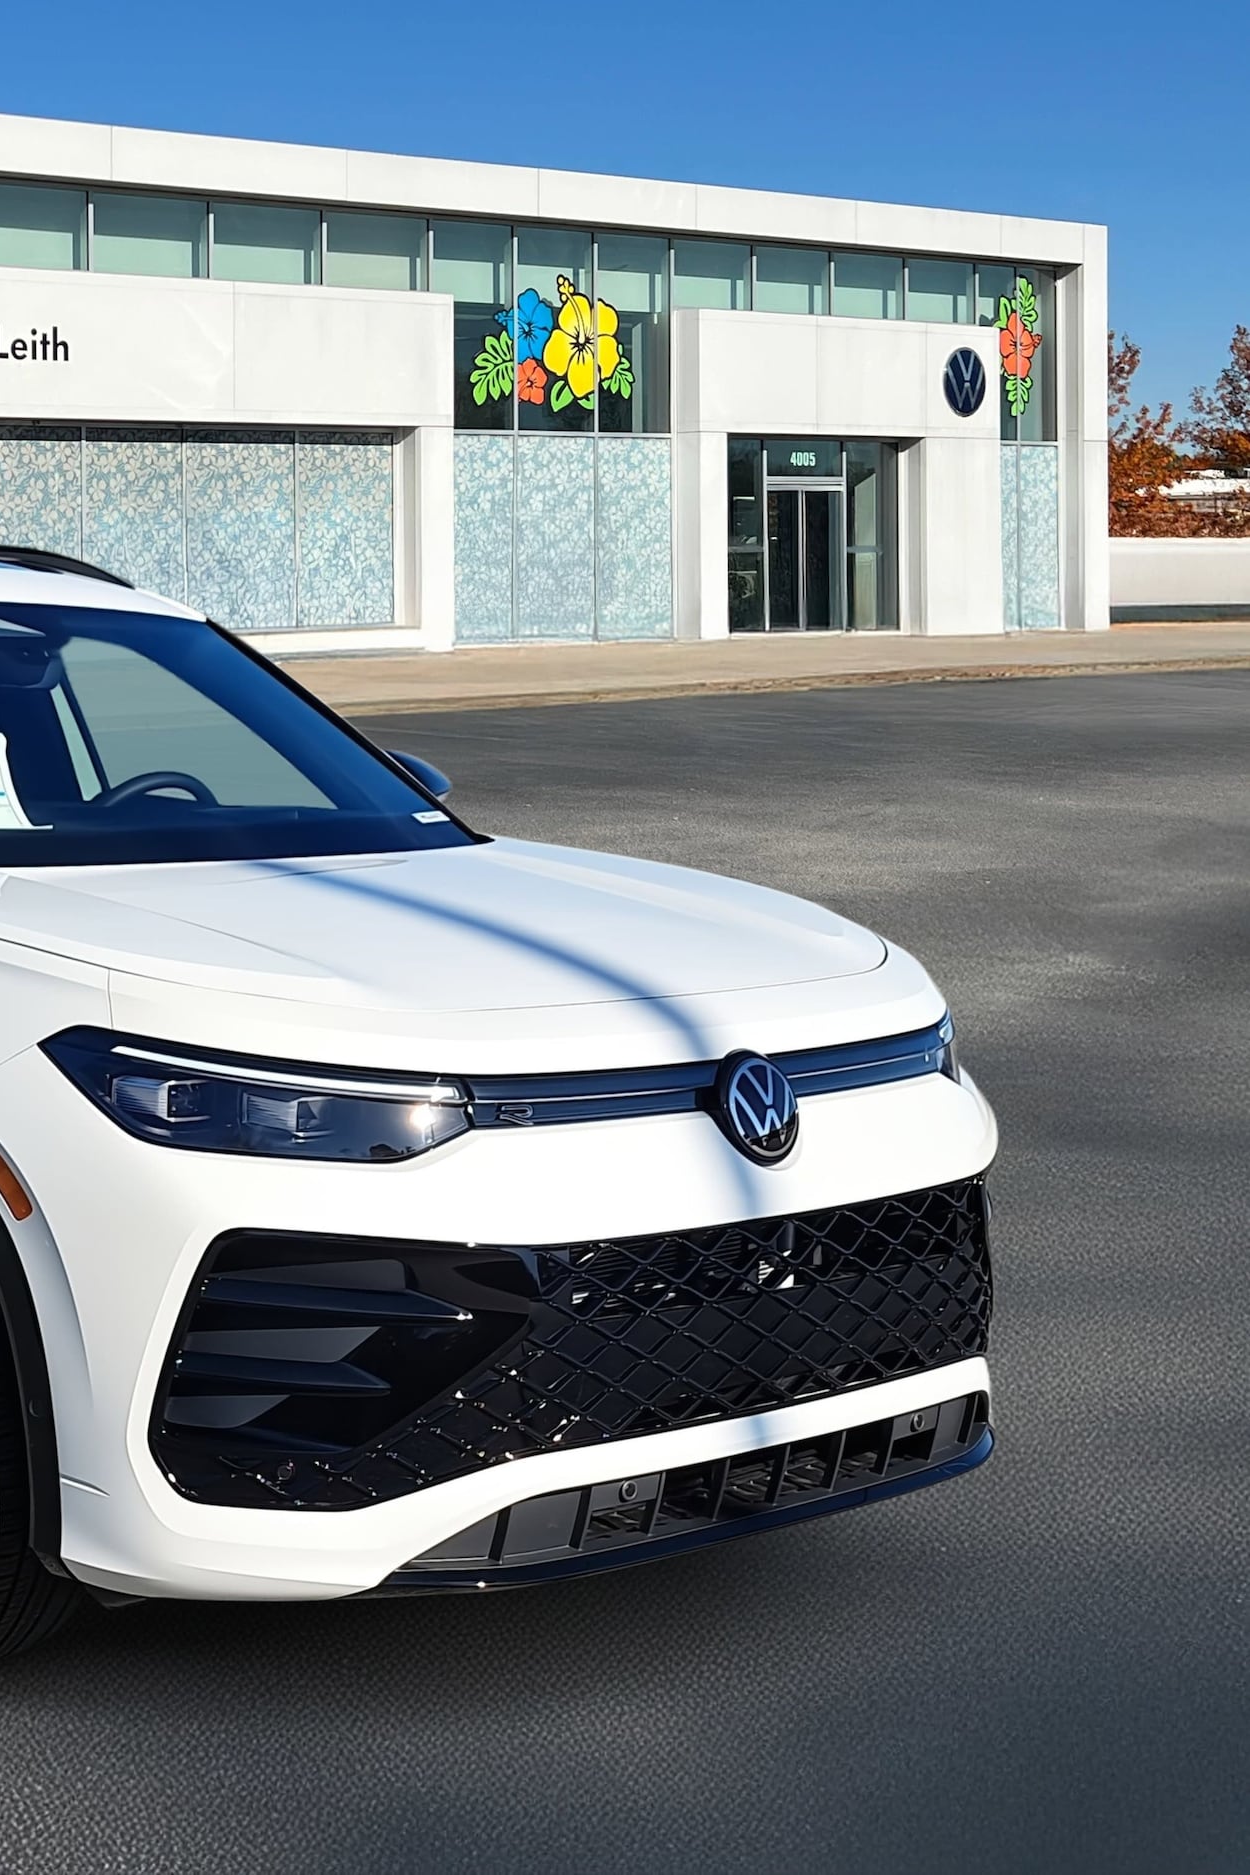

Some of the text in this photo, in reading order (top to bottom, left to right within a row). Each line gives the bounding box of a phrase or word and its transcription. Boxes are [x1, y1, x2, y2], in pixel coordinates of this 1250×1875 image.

[946, 349, 984, 410] VW
[790, 451, 816, 467] 4005
[499, 1104, 534, 1126] R
[729, 1059, 795, 1150] VW
